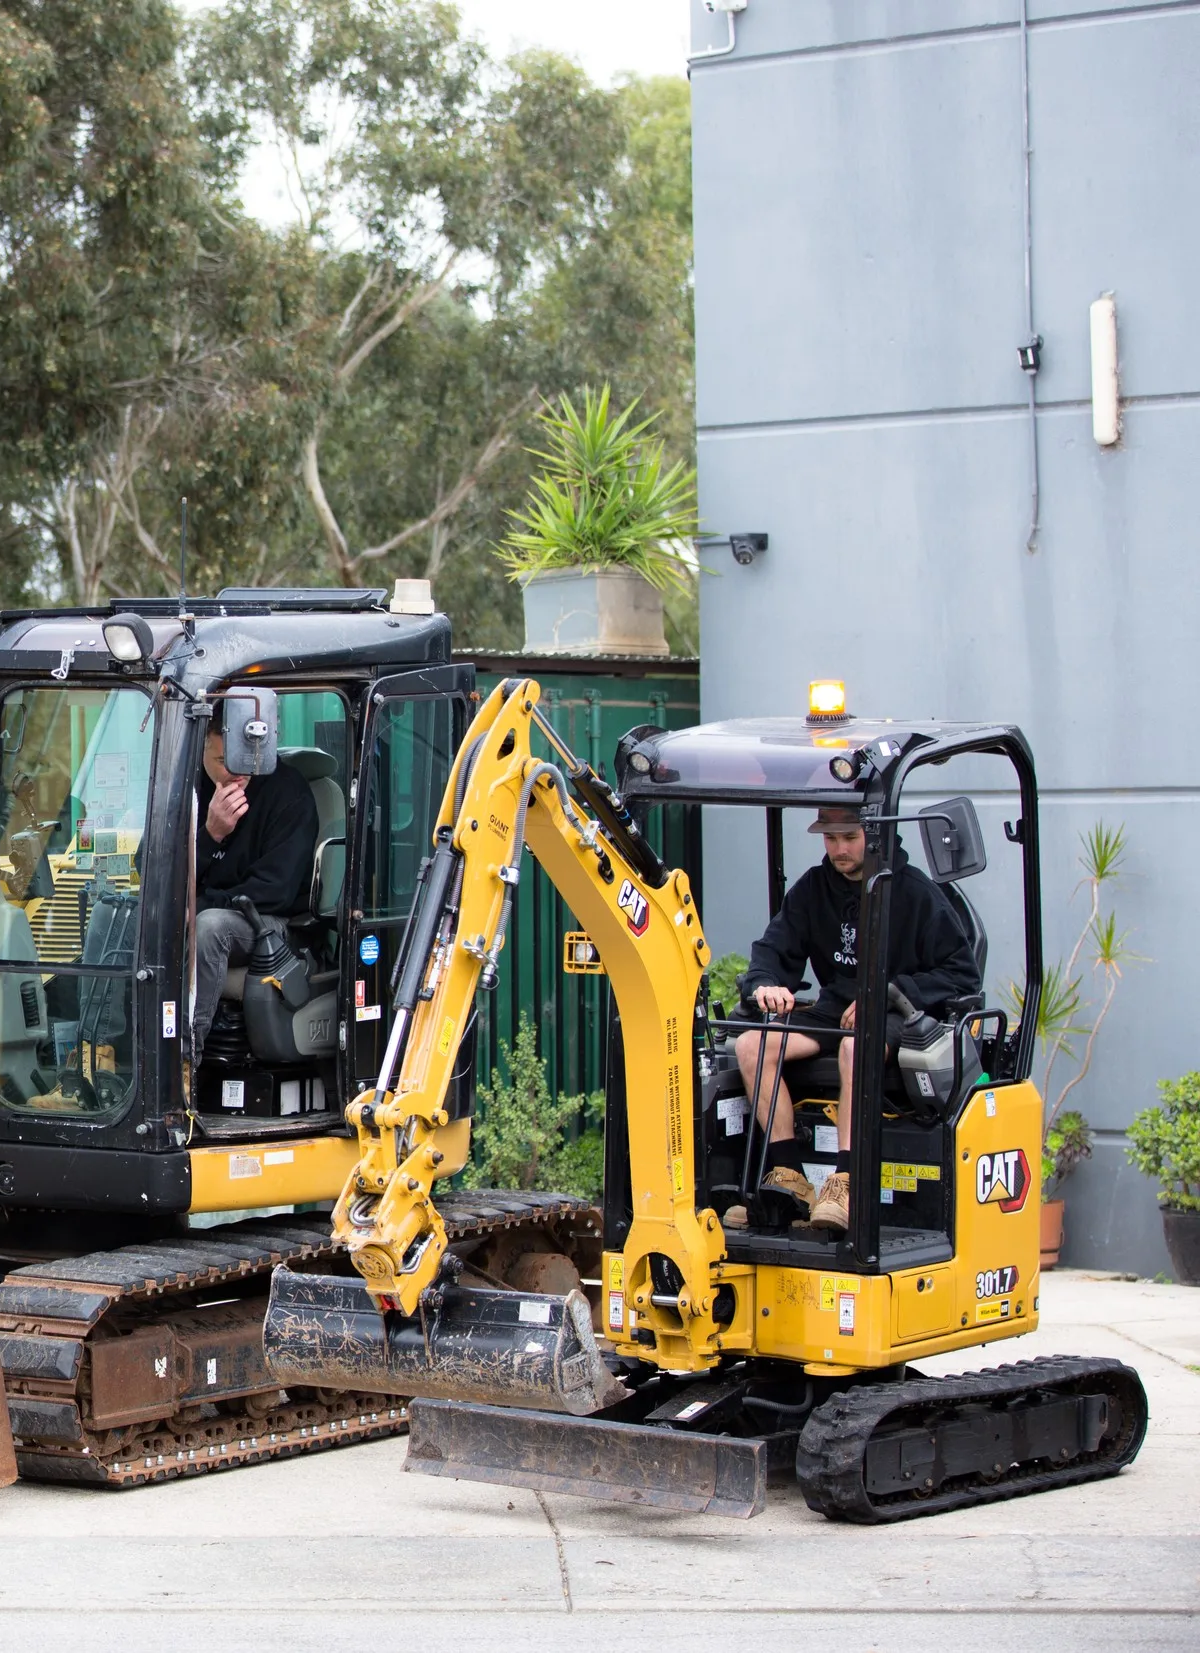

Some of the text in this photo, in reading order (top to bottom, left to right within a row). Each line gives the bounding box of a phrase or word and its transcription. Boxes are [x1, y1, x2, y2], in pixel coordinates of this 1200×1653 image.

[489, 814, 509, 835] GIANT
[617, 878, 648, 925] CAT
[833, 951, 858, 966] GIAN
[976, 1150, 1019, 1203] CAT
[975, 1267, 1013, 1299] 301.7
